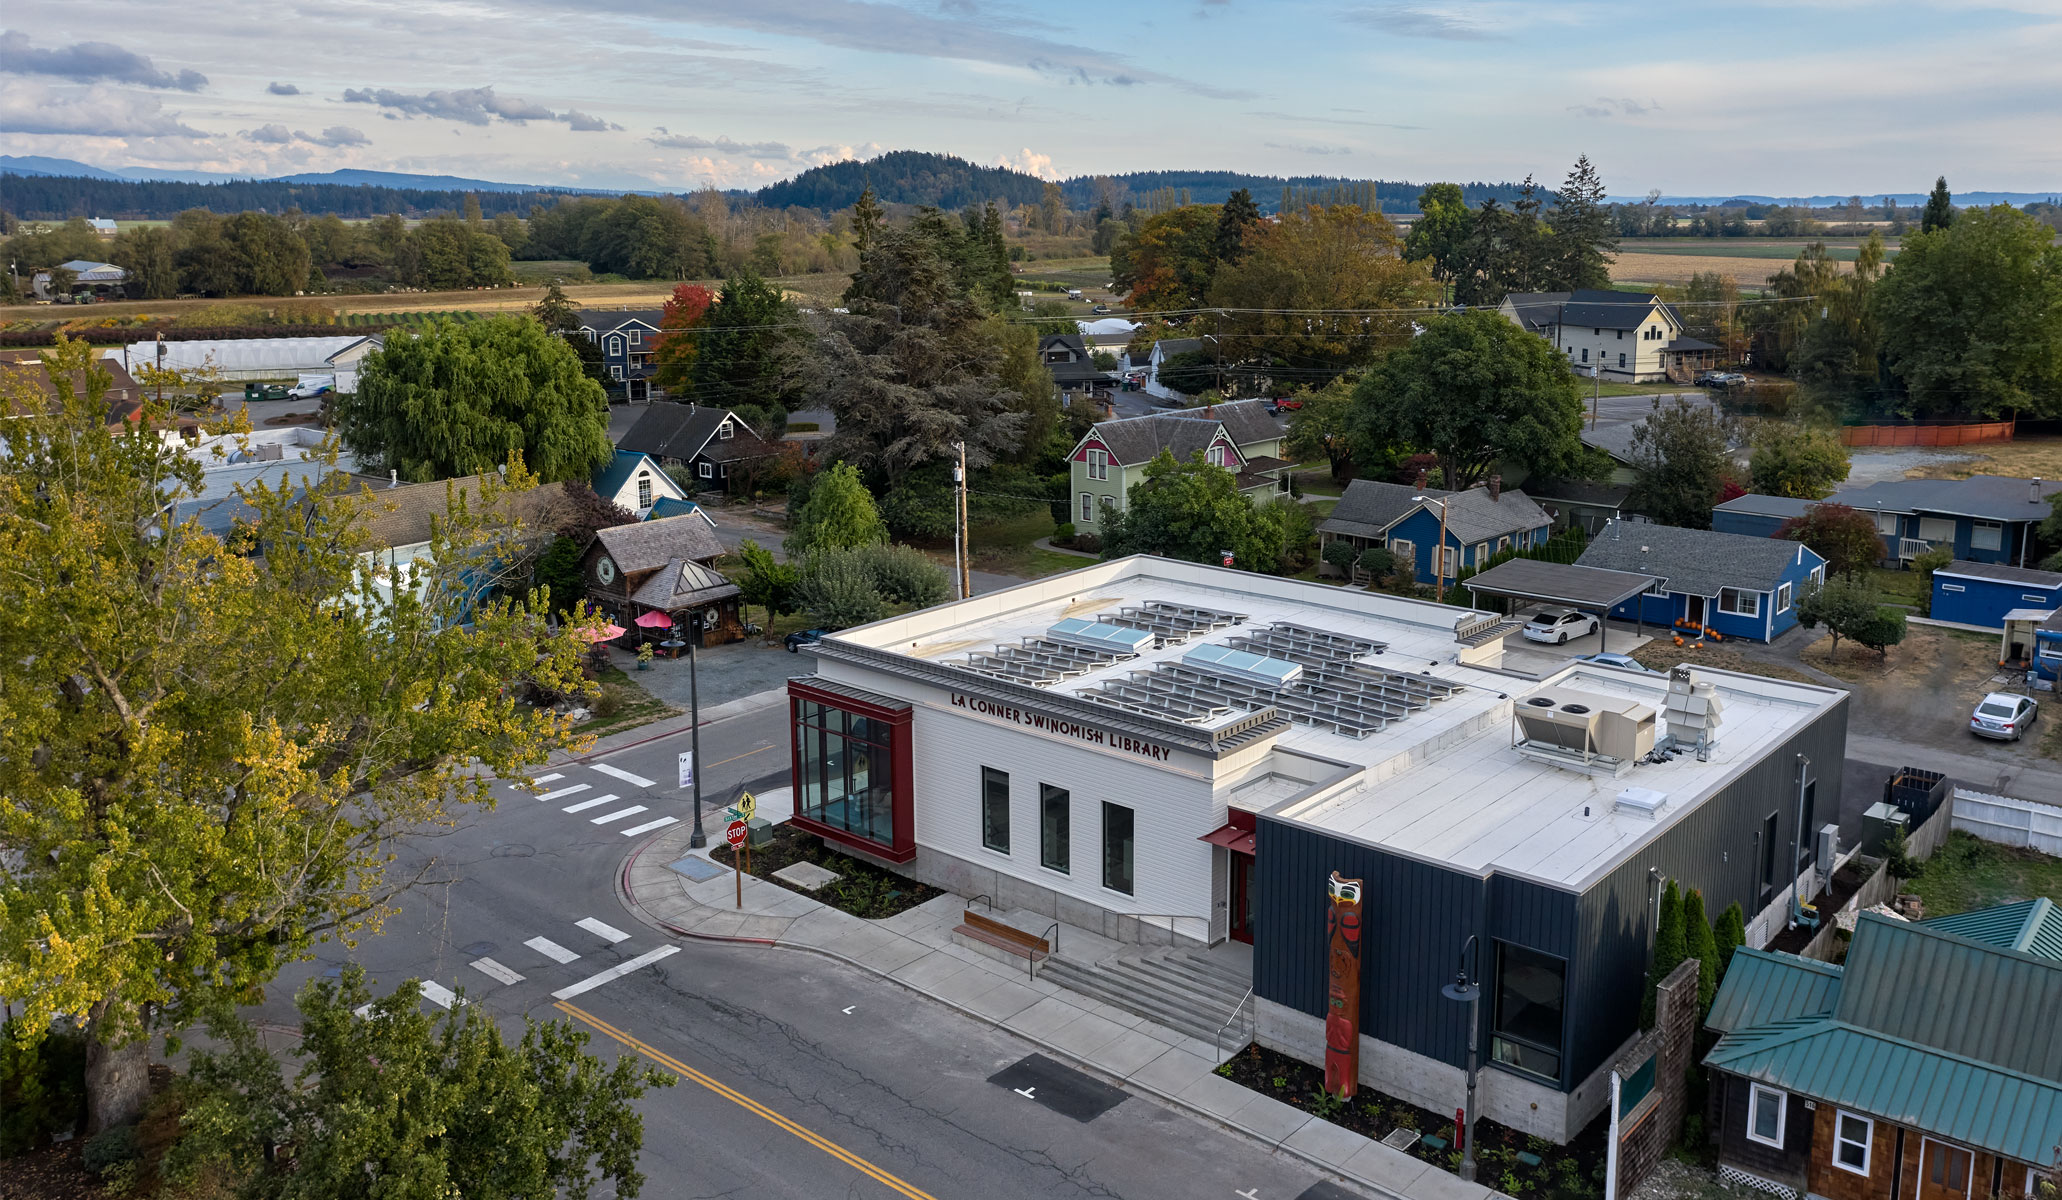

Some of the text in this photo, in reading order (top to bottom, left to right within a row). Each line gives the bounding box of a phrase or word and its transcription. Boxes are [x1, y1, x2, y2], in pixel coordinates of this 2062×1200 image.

[952, 693, 1170, 761] LA CONNER SWINOMISH LIBRARY
[727, 825, 746, 840] STOP
